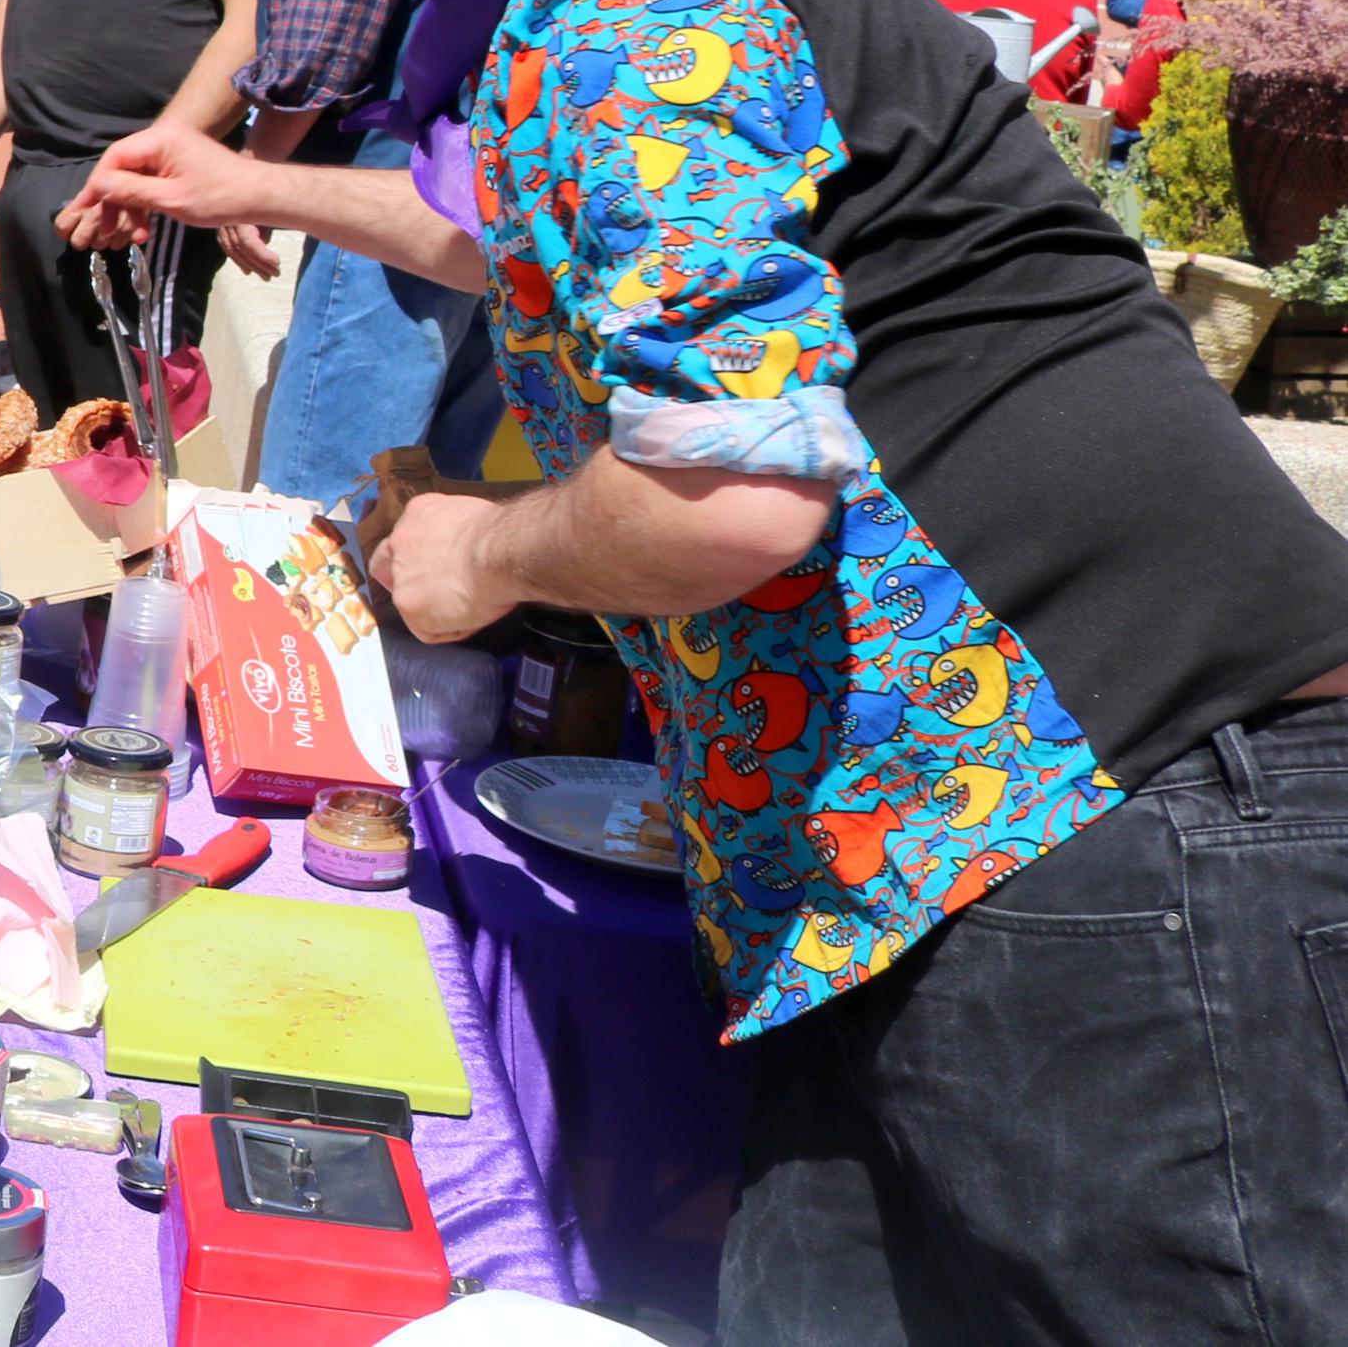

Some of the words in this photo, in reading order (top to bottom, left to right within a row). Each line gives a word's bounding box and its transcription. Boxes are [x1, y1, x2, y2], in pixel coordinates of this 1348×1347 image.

[281, 634, 306, 703] Biscote
[308, 664, 324, 696] Tostas
[313, 697, 326, 722] Mini
[291, 707, 314, 747] Mini
[384, 754, 399, 772] 60
[247, 773, 272, 783] Mini
[273, 776, 316, 788] Biscote
